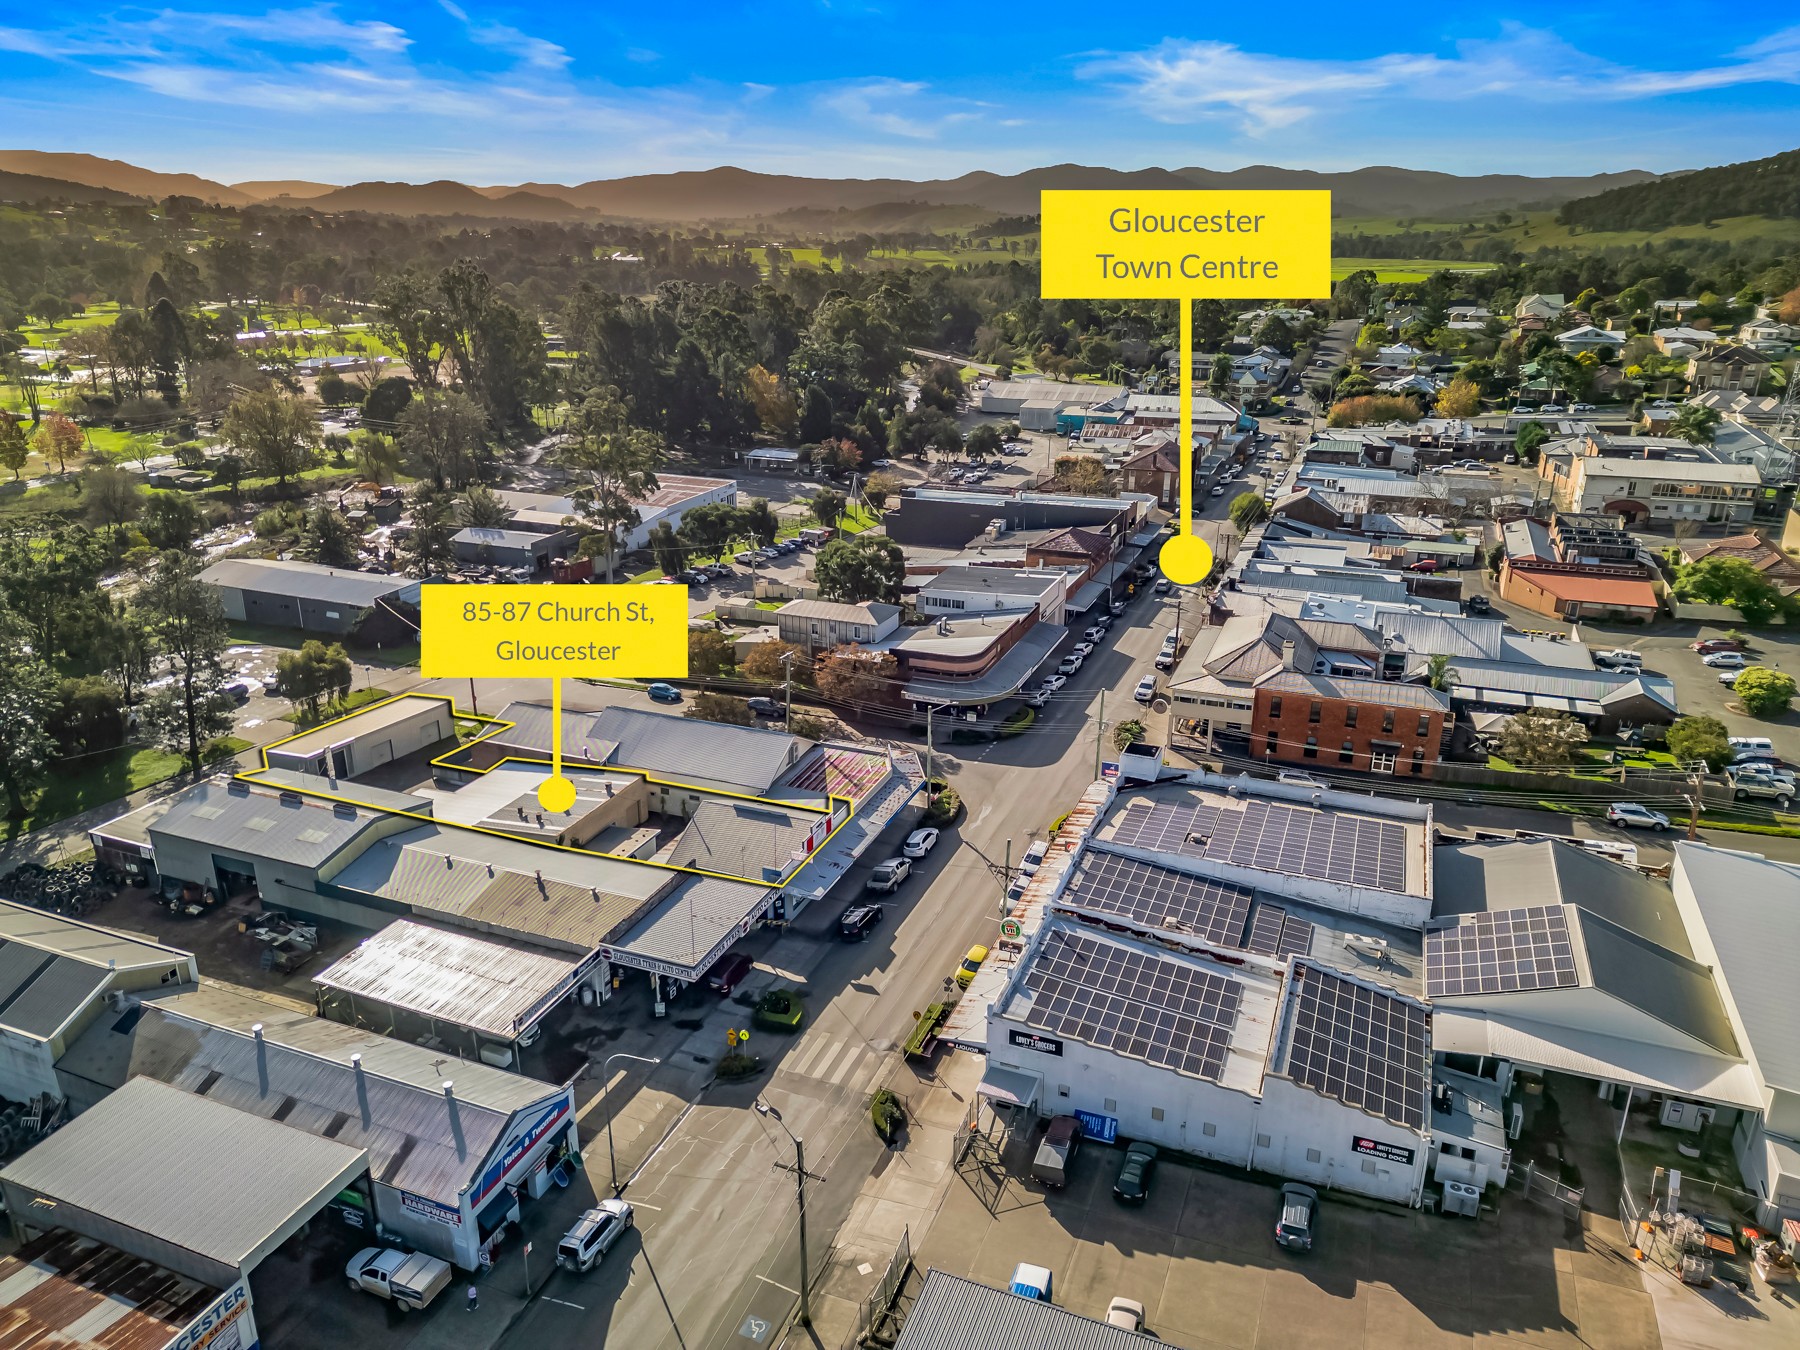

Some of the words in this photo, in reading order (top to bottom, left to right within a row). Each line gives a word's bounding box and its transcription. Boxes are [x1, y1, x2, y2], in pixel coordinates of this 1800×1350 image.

[613, 952, 642, 965] GLOUCESTER
[662, 964, 674, 974] AUTO
[955, 1043, 979, 1053] LIQUOR
[503, 1145, 523, 1168] Yates
[531, 1108, 559, 1139] Twomey
[1360, 1139, 1375, 1148] IGA
[1357, 1146, 1387, 1158] LOADING
[1388, 1153, 1408, 1163] DOCK
[404, 1198, 459, 1223] HARDWARE
[170, 1286, 245, 1350] CESTER
[208, 1300, 248, 1339] SERVICE
